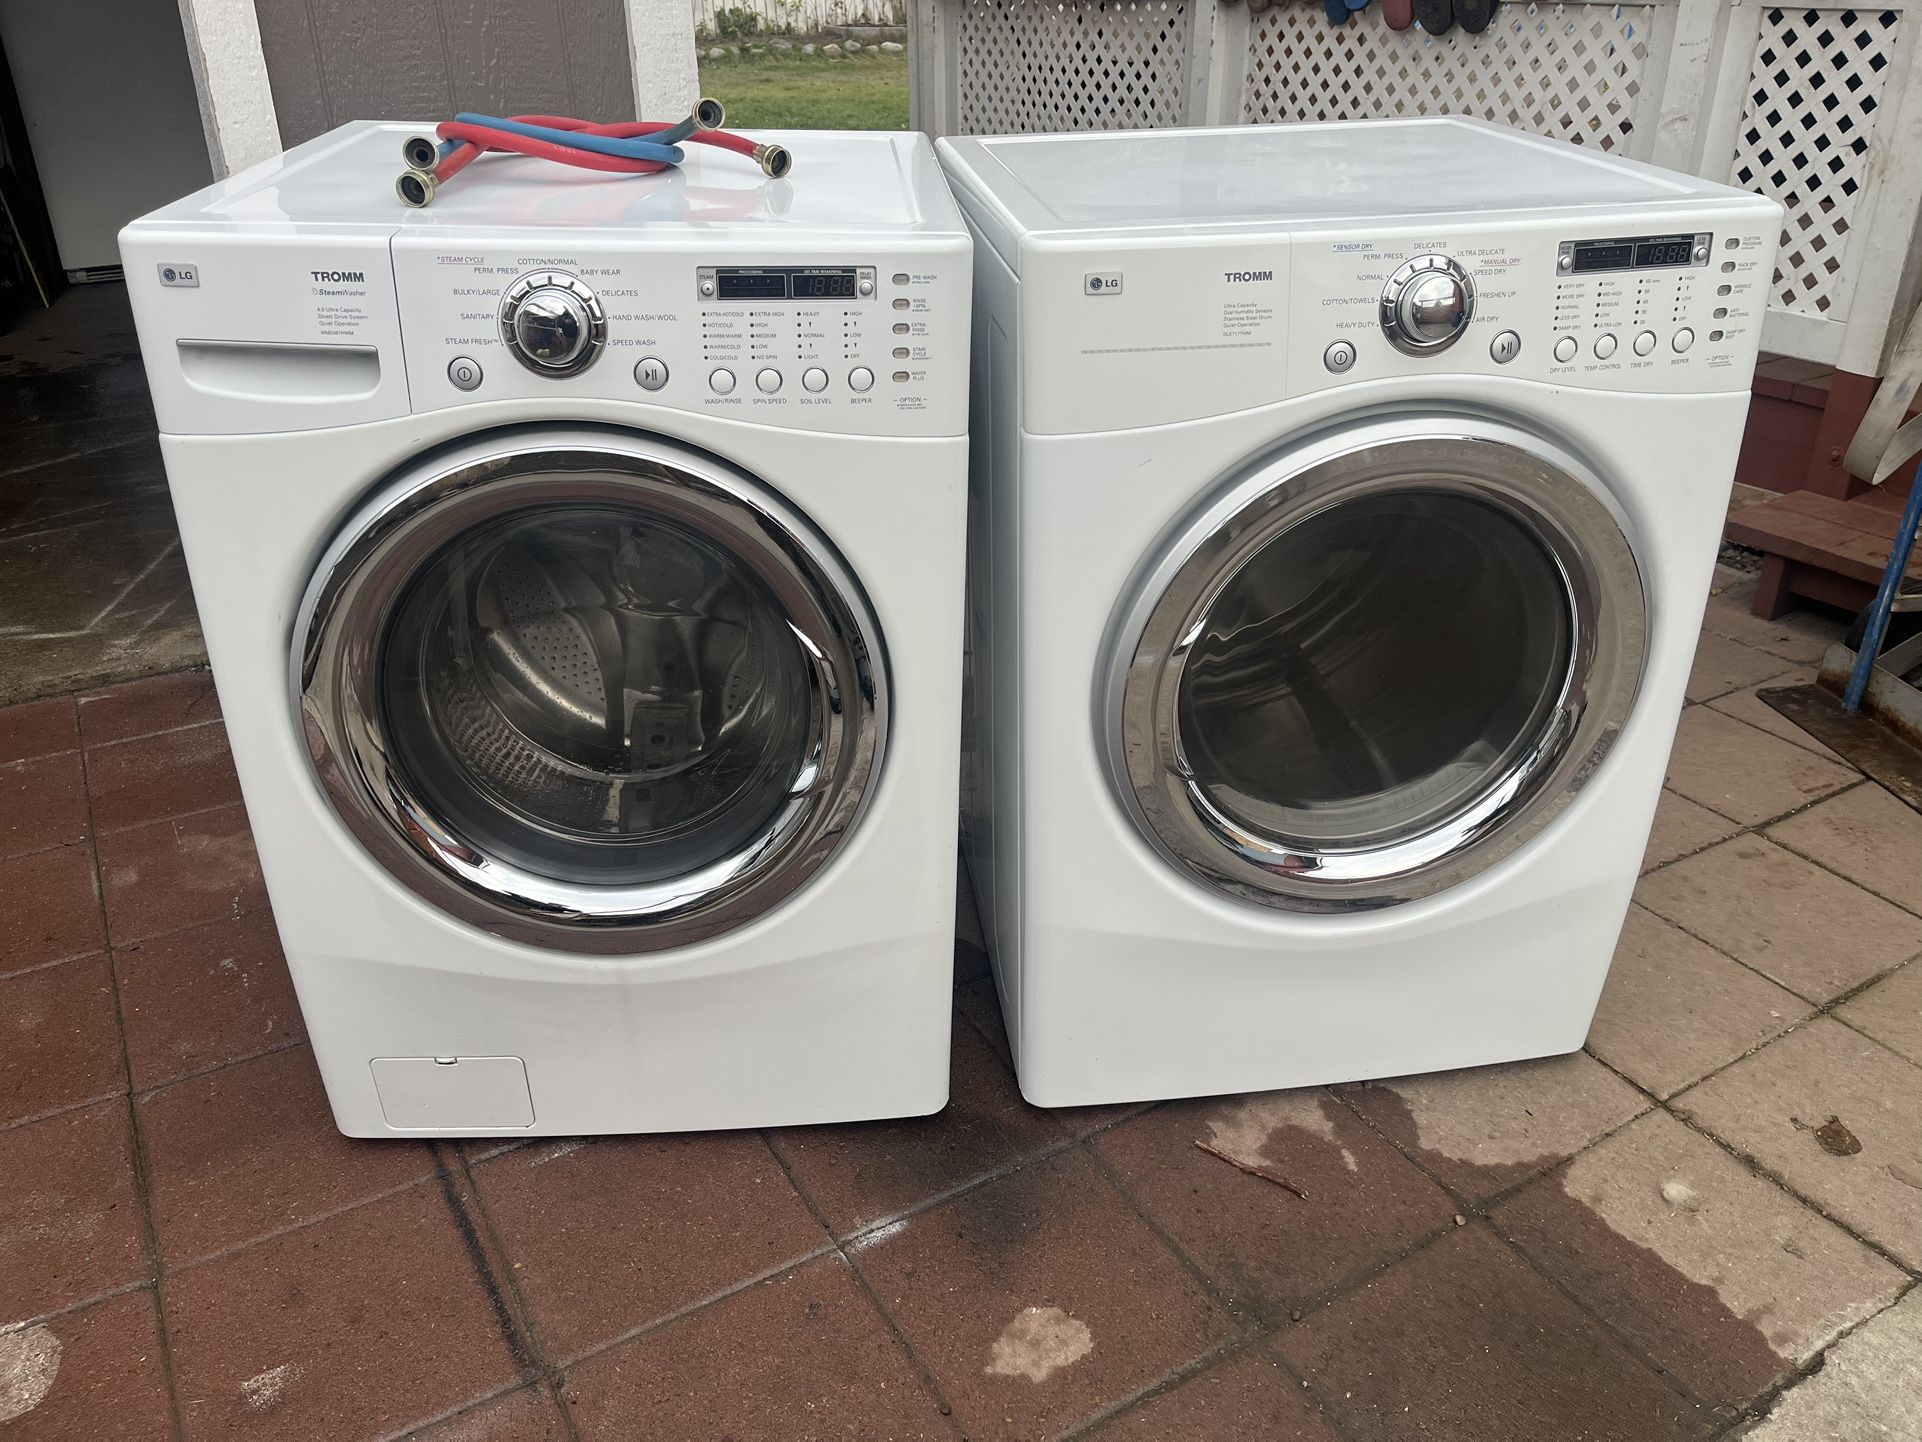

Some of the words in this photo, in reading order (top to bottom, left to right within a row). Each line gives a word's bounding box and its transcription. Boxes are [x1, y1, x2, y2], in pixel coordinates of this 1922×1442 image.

[1414, 242, 1447, 250] DELICATES
[517, 258, 579, 266] COTTON/NORMAL
[179, 271, 193, 280] LG
[311, 271, 365, 283] TROMM
[1224, 271, 1273, 283] TROMM
[1105, 279, 1118, 288] LG
[319, 288, 367, 297] SteamWasher
[1322, 297, 1376, 306] COTTON/TOWELS
